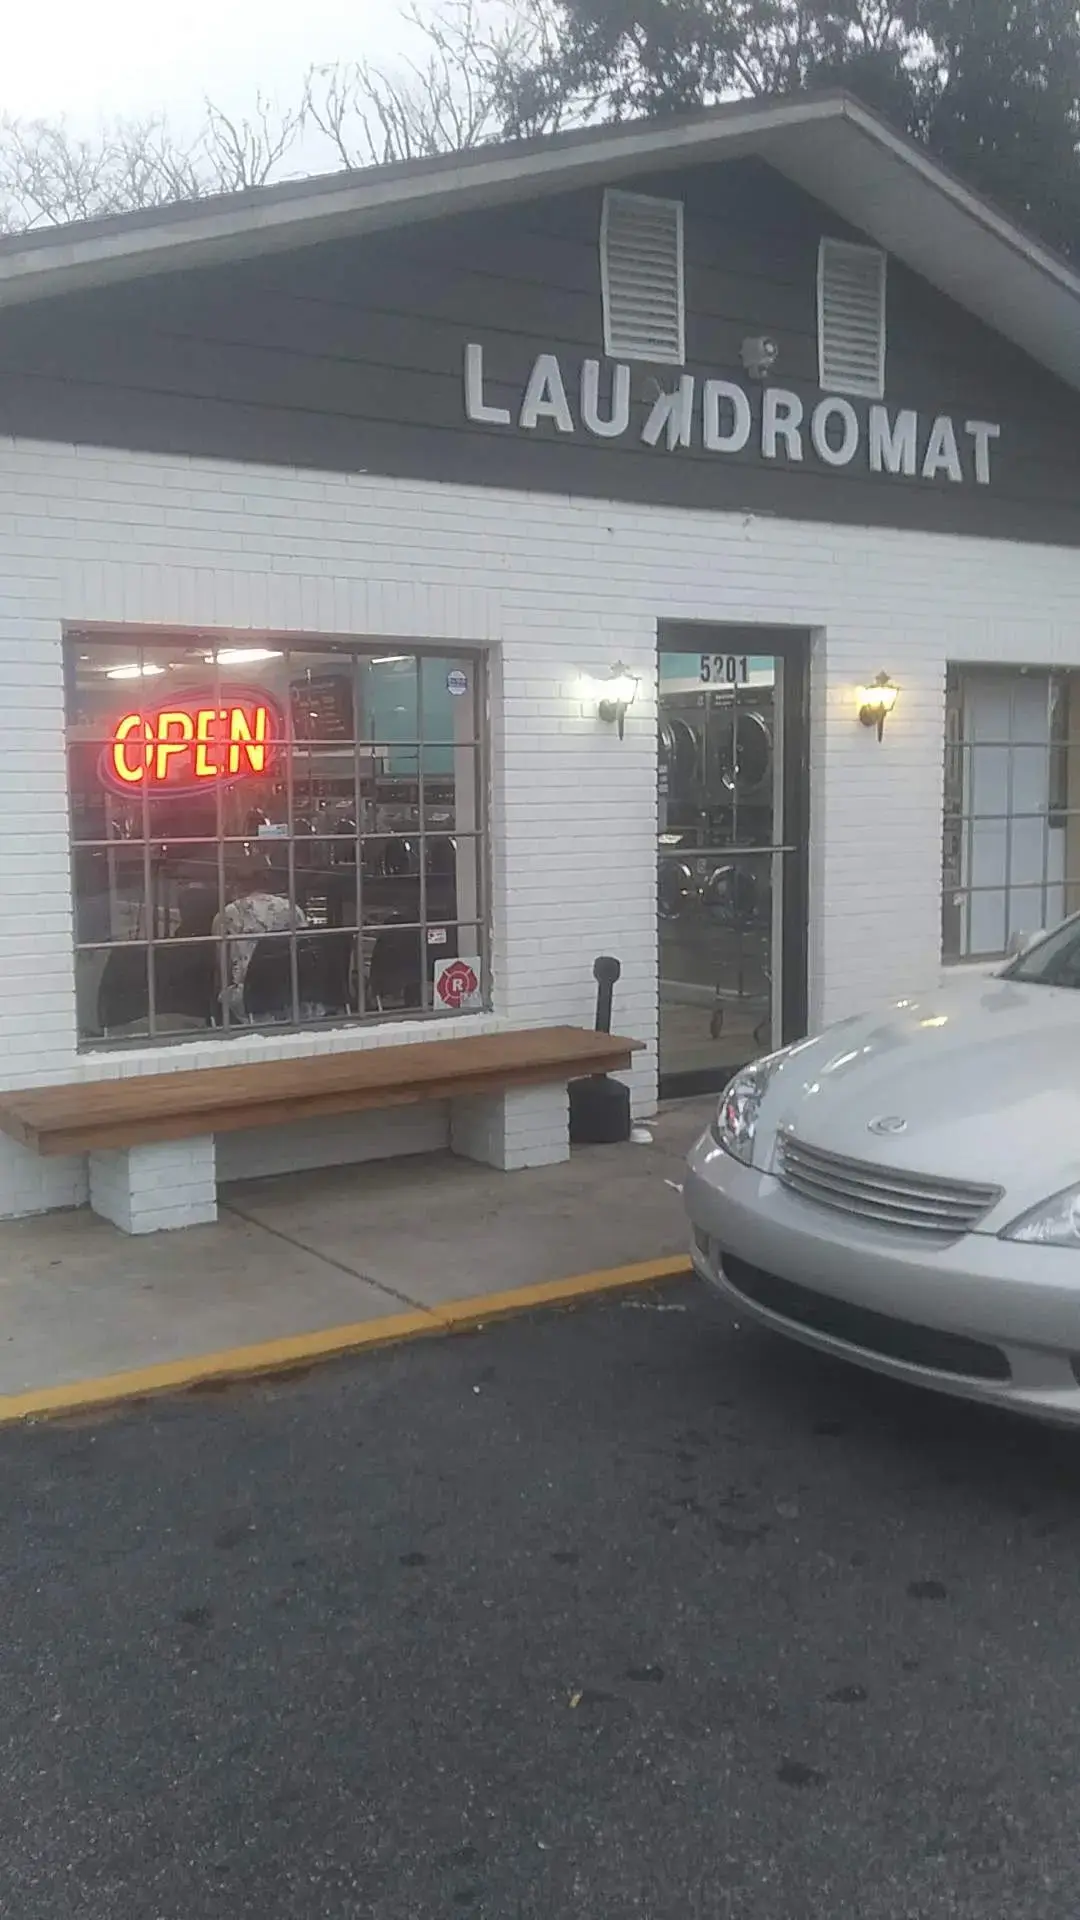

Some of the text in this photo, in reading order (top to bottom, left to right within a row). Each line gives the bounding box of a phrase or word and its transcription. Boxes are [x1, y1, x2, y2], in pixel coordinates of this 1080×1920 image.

[464, 343, 1000, 485] LAUNDROMAT
[700, 655, 748, 683] 5201
[113, 706, 266, 782] OPEN
[452, 979, 465, 992] R
